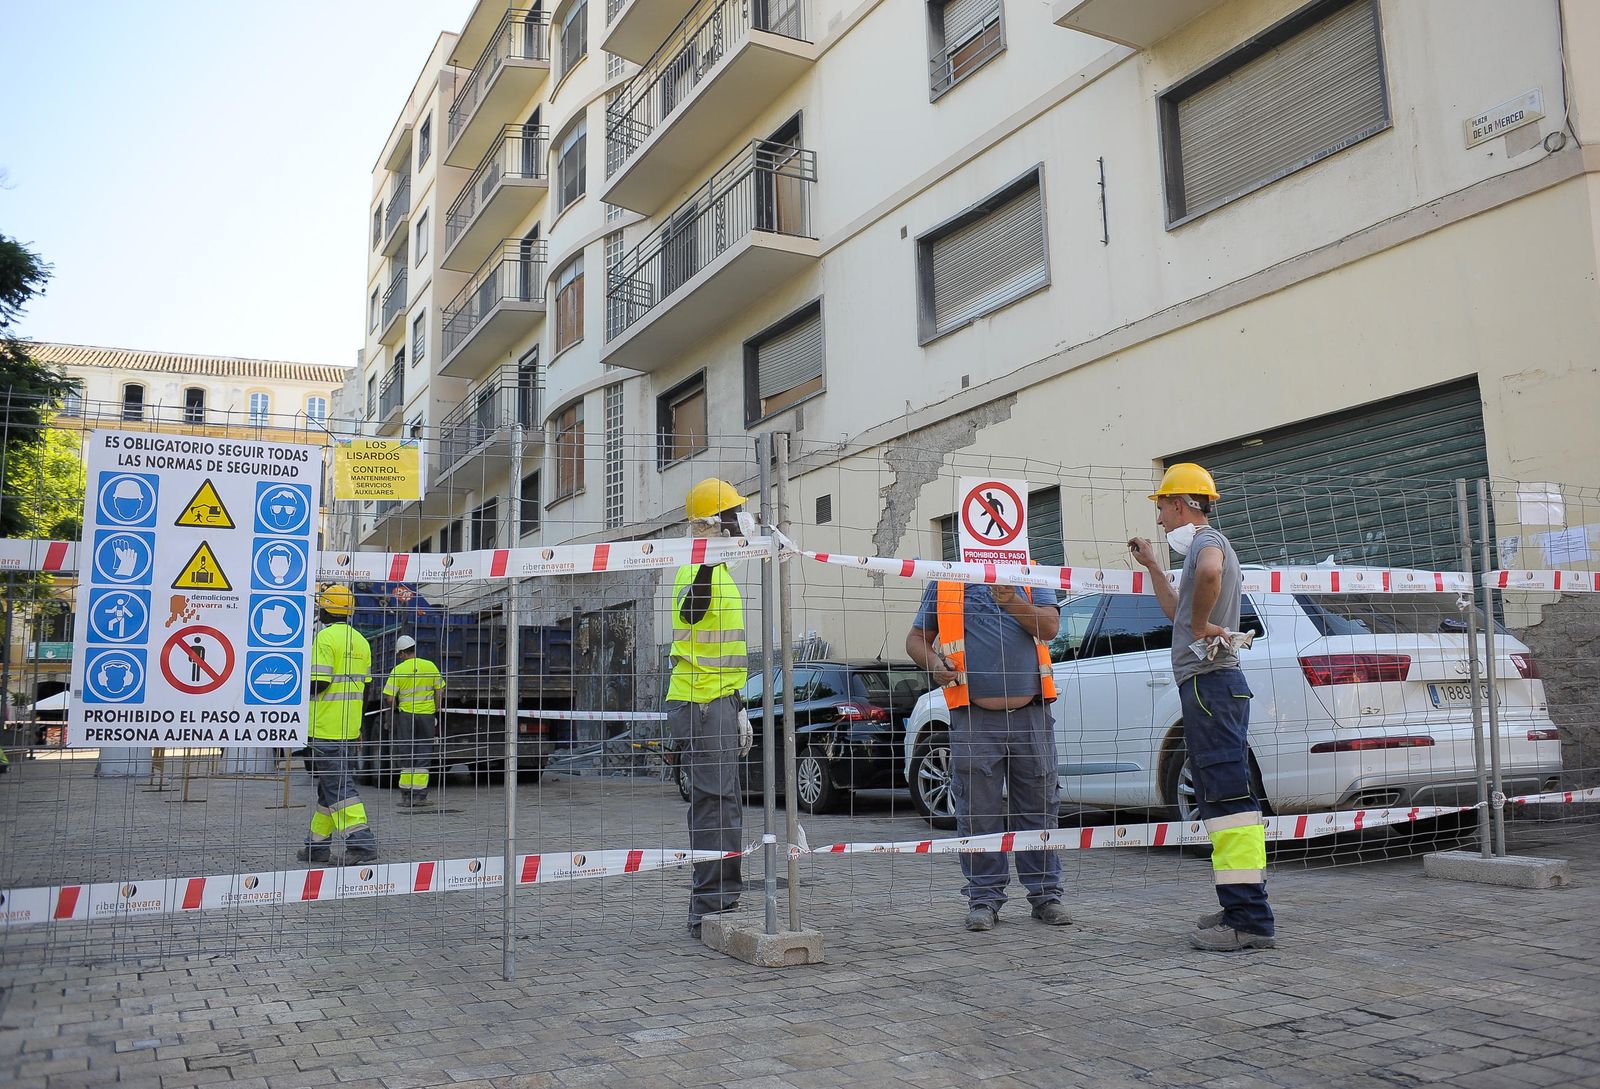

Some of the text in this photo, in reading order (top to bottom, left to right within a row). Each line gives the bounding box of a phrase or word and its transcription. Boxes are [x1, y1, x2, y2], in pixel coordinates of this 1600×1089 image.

[1473, 110, 1524, 139] DE LA MERCED
[105, 436, 308, 462] ES OBLIGATORIO SEGUIR TODAS
[365, 441, 387, 449] LOS
[346, 452, 400, 460] LISARDOS
[118, 453, 299, 477] LAS NORMAS DE SEGURIDAD
[352, 466, 400, 474] CONTROL
[623, 556, 674, 564] riberanavarra
[965, 551, 998, 559] PROHIBIDO
[522, 562, 575, 570] riberanavarra
[1441, 685, 1471, 700] 1889
[84, 710, 301, 723] PROHIBIDO EL PASO A TODA
[85, 728, 298, 741] PERSONA AJENA A LA OBRA
[448, 875, 503, 884] riberanavarra
[338, 882, 395, 893] riberanavarra
[96, 900, 161, 911] riberanavarra
